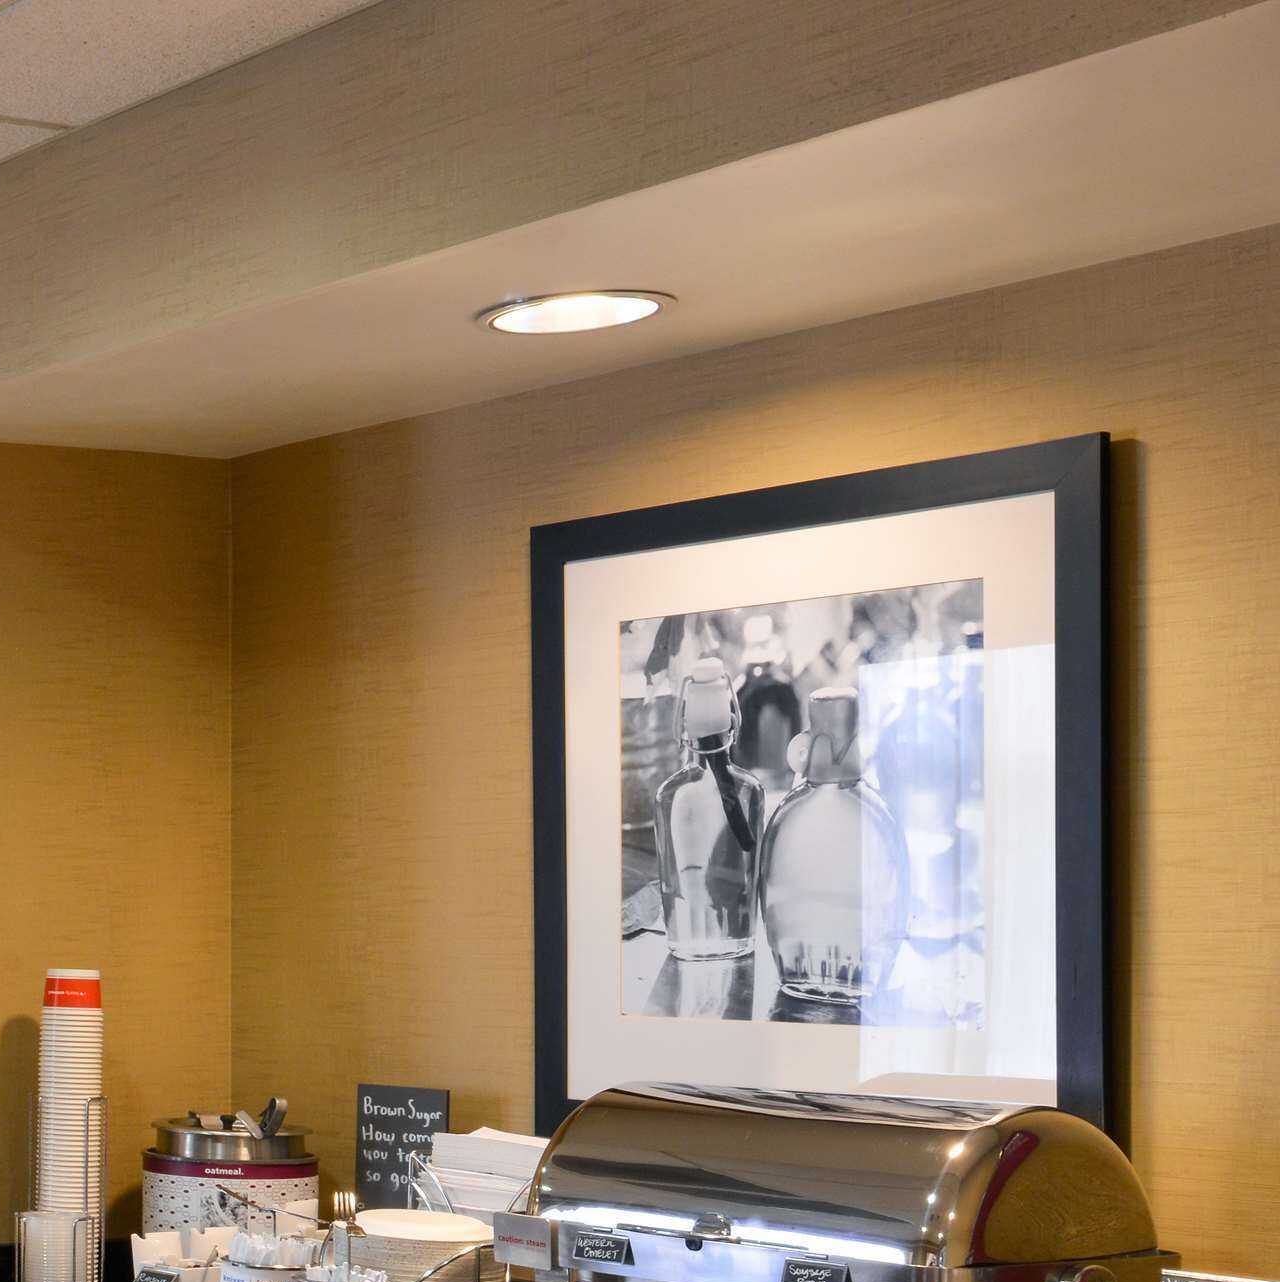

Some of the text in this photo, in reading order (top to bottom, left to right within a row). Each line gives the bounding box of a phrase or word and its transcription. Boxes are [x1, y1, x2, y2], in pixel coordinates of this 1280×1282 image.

[363, 1095, 443, 1127] Brown Sugar
[361, 1123, 432, 1143] How com
[363, 1149, 388, 1161] you
[204, 1167, 244, 1176] oatmeal.
[366, 1169, 381, 1182] so
